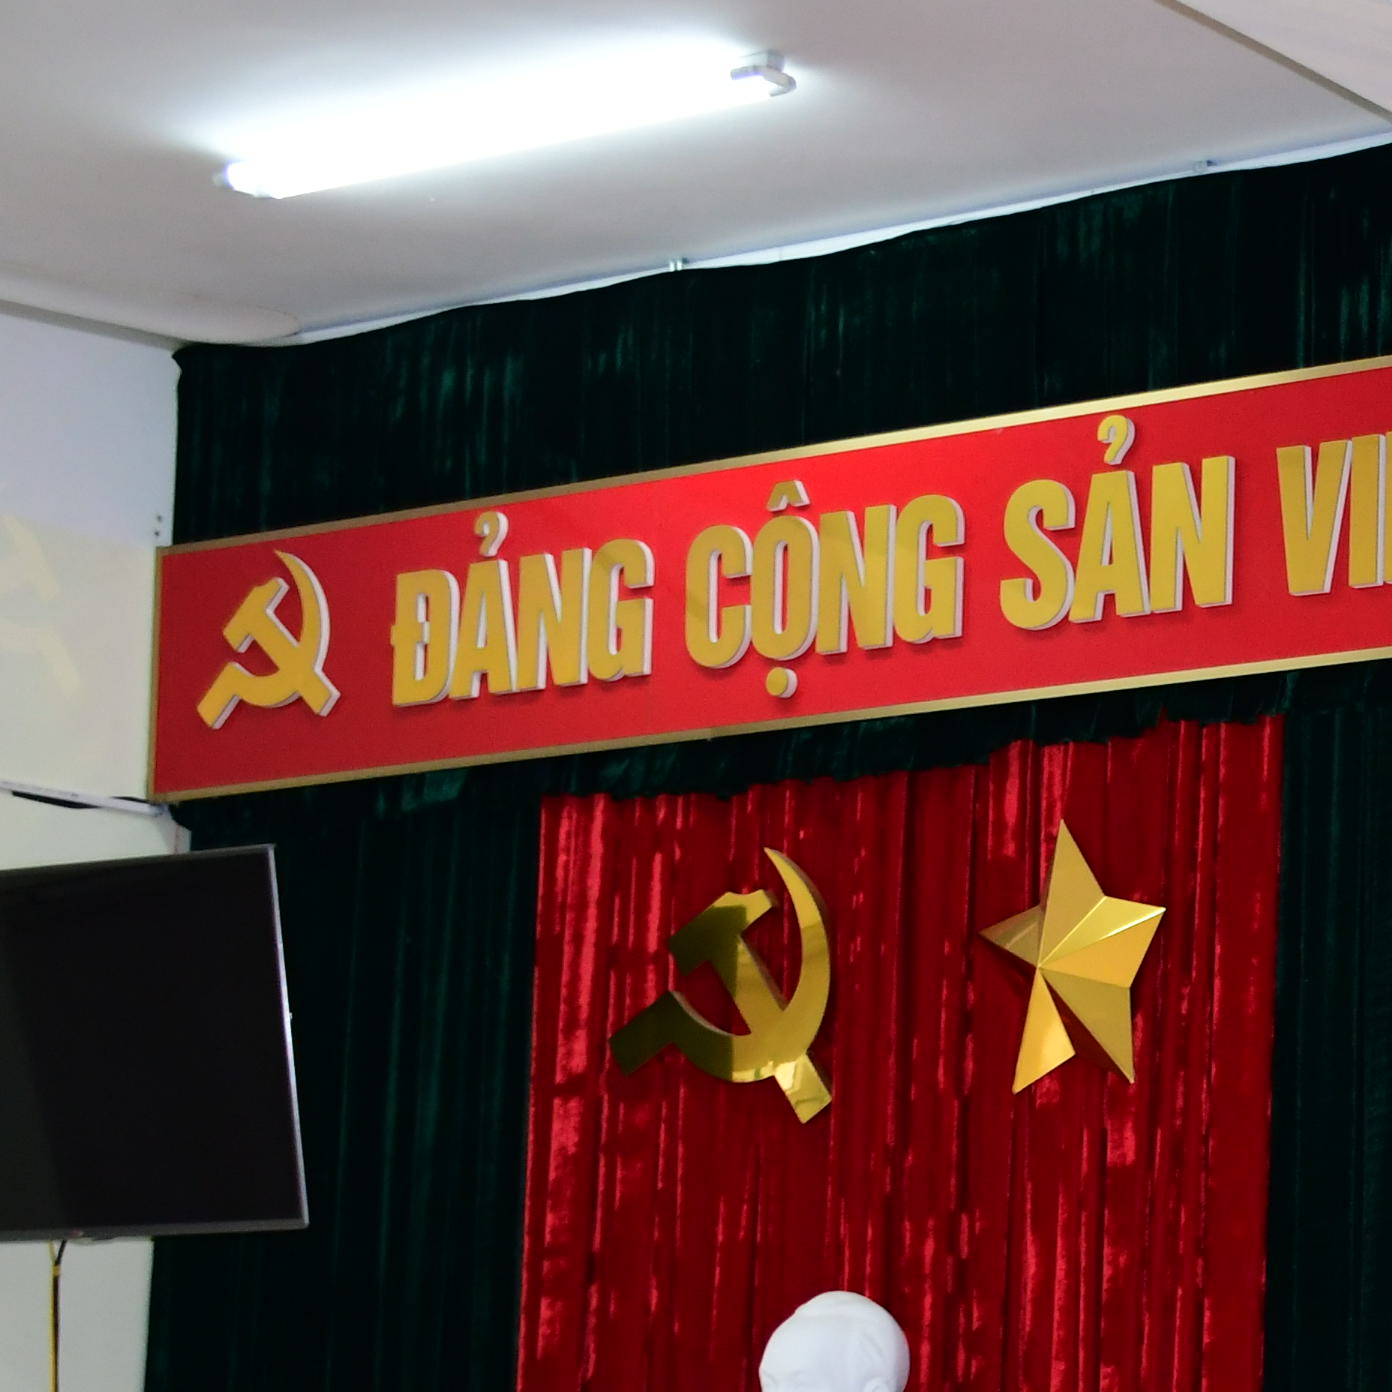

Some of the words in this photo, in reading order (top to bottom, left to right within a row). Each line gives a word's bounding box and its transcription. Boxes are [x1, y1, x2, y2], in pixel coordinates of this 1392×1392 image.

[389, 508, 656, 710] ĐẢNG
[684, 476, 968, 700] CỘNG
[998, 412, 1238, 633] SẢN
